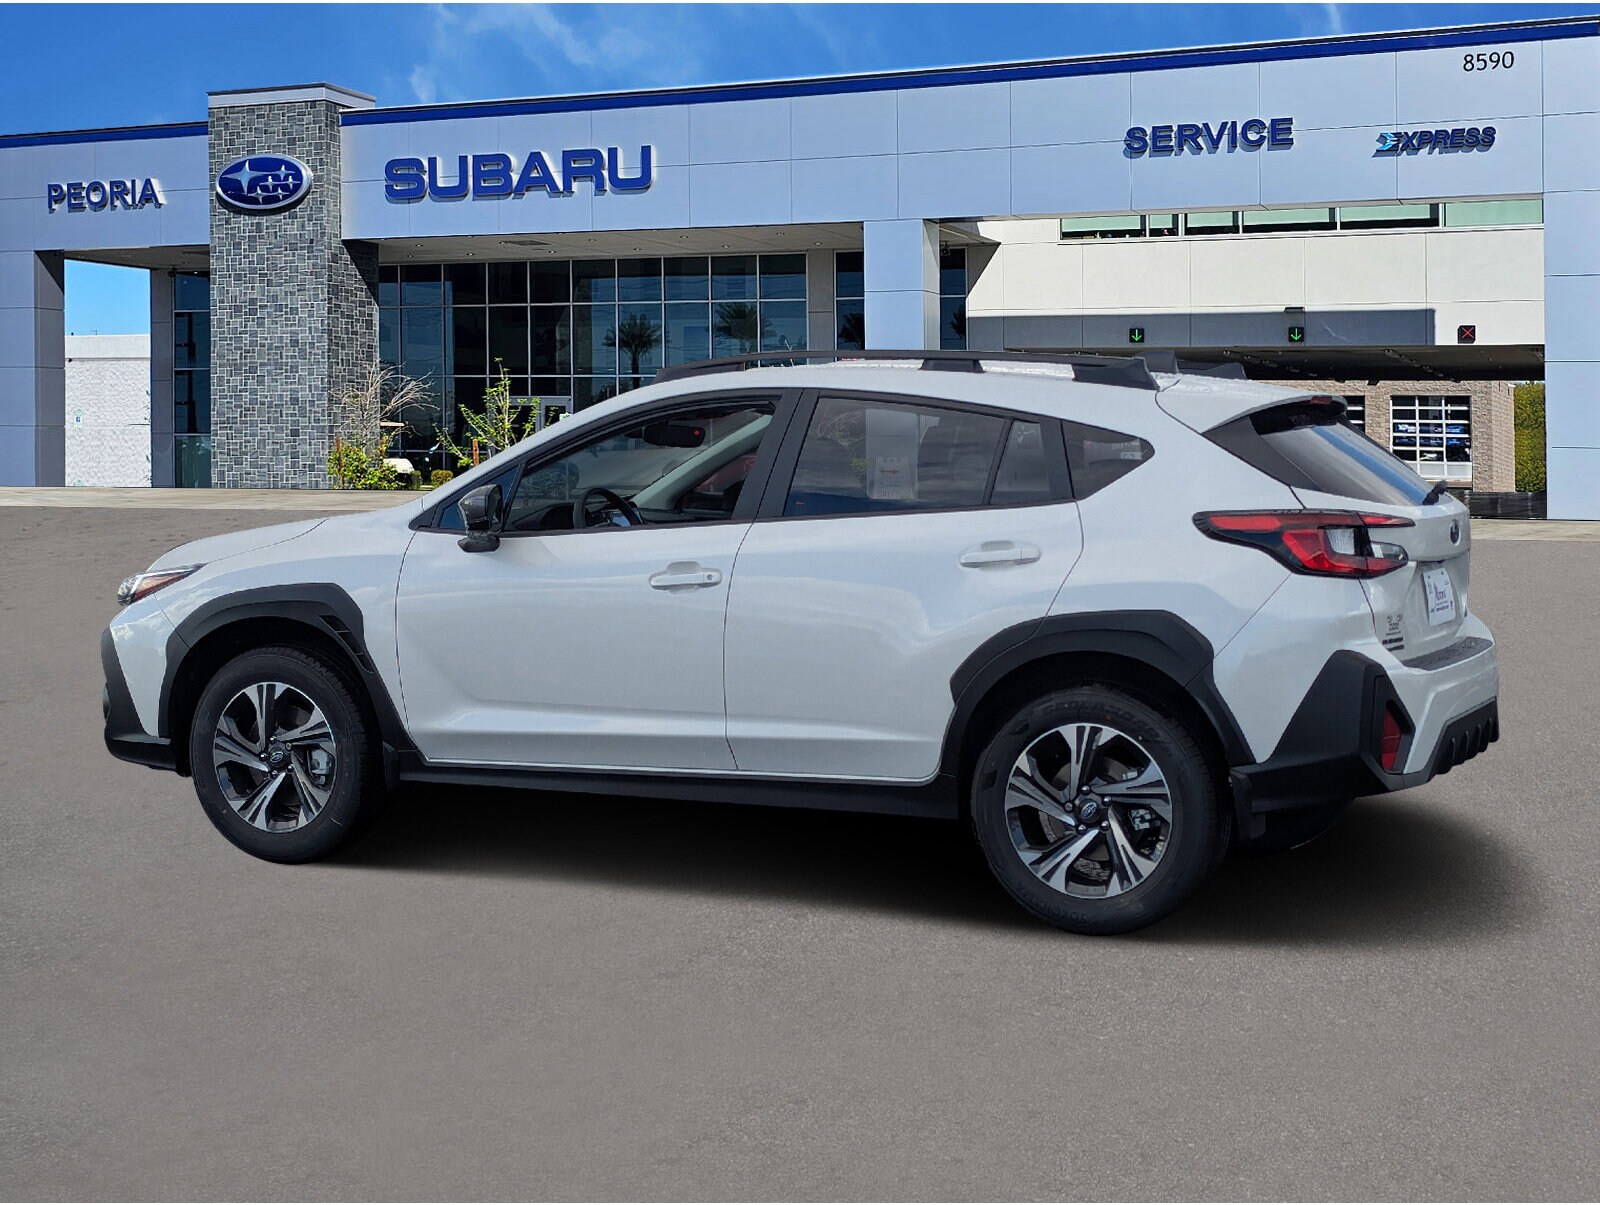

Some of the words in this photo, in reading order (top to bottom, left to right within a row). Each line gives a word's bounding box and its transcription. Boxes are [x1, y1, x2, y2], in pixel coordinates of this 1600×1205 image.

[1462, 51, 1515, 72] 8590
[1124, 117, 1294, 153] SERVICE
[1376, 126, 1497, 151] EXPRESS
[384, 145, 652, 199] SUBARU
[47, 178, 161, 210] PEORIA
